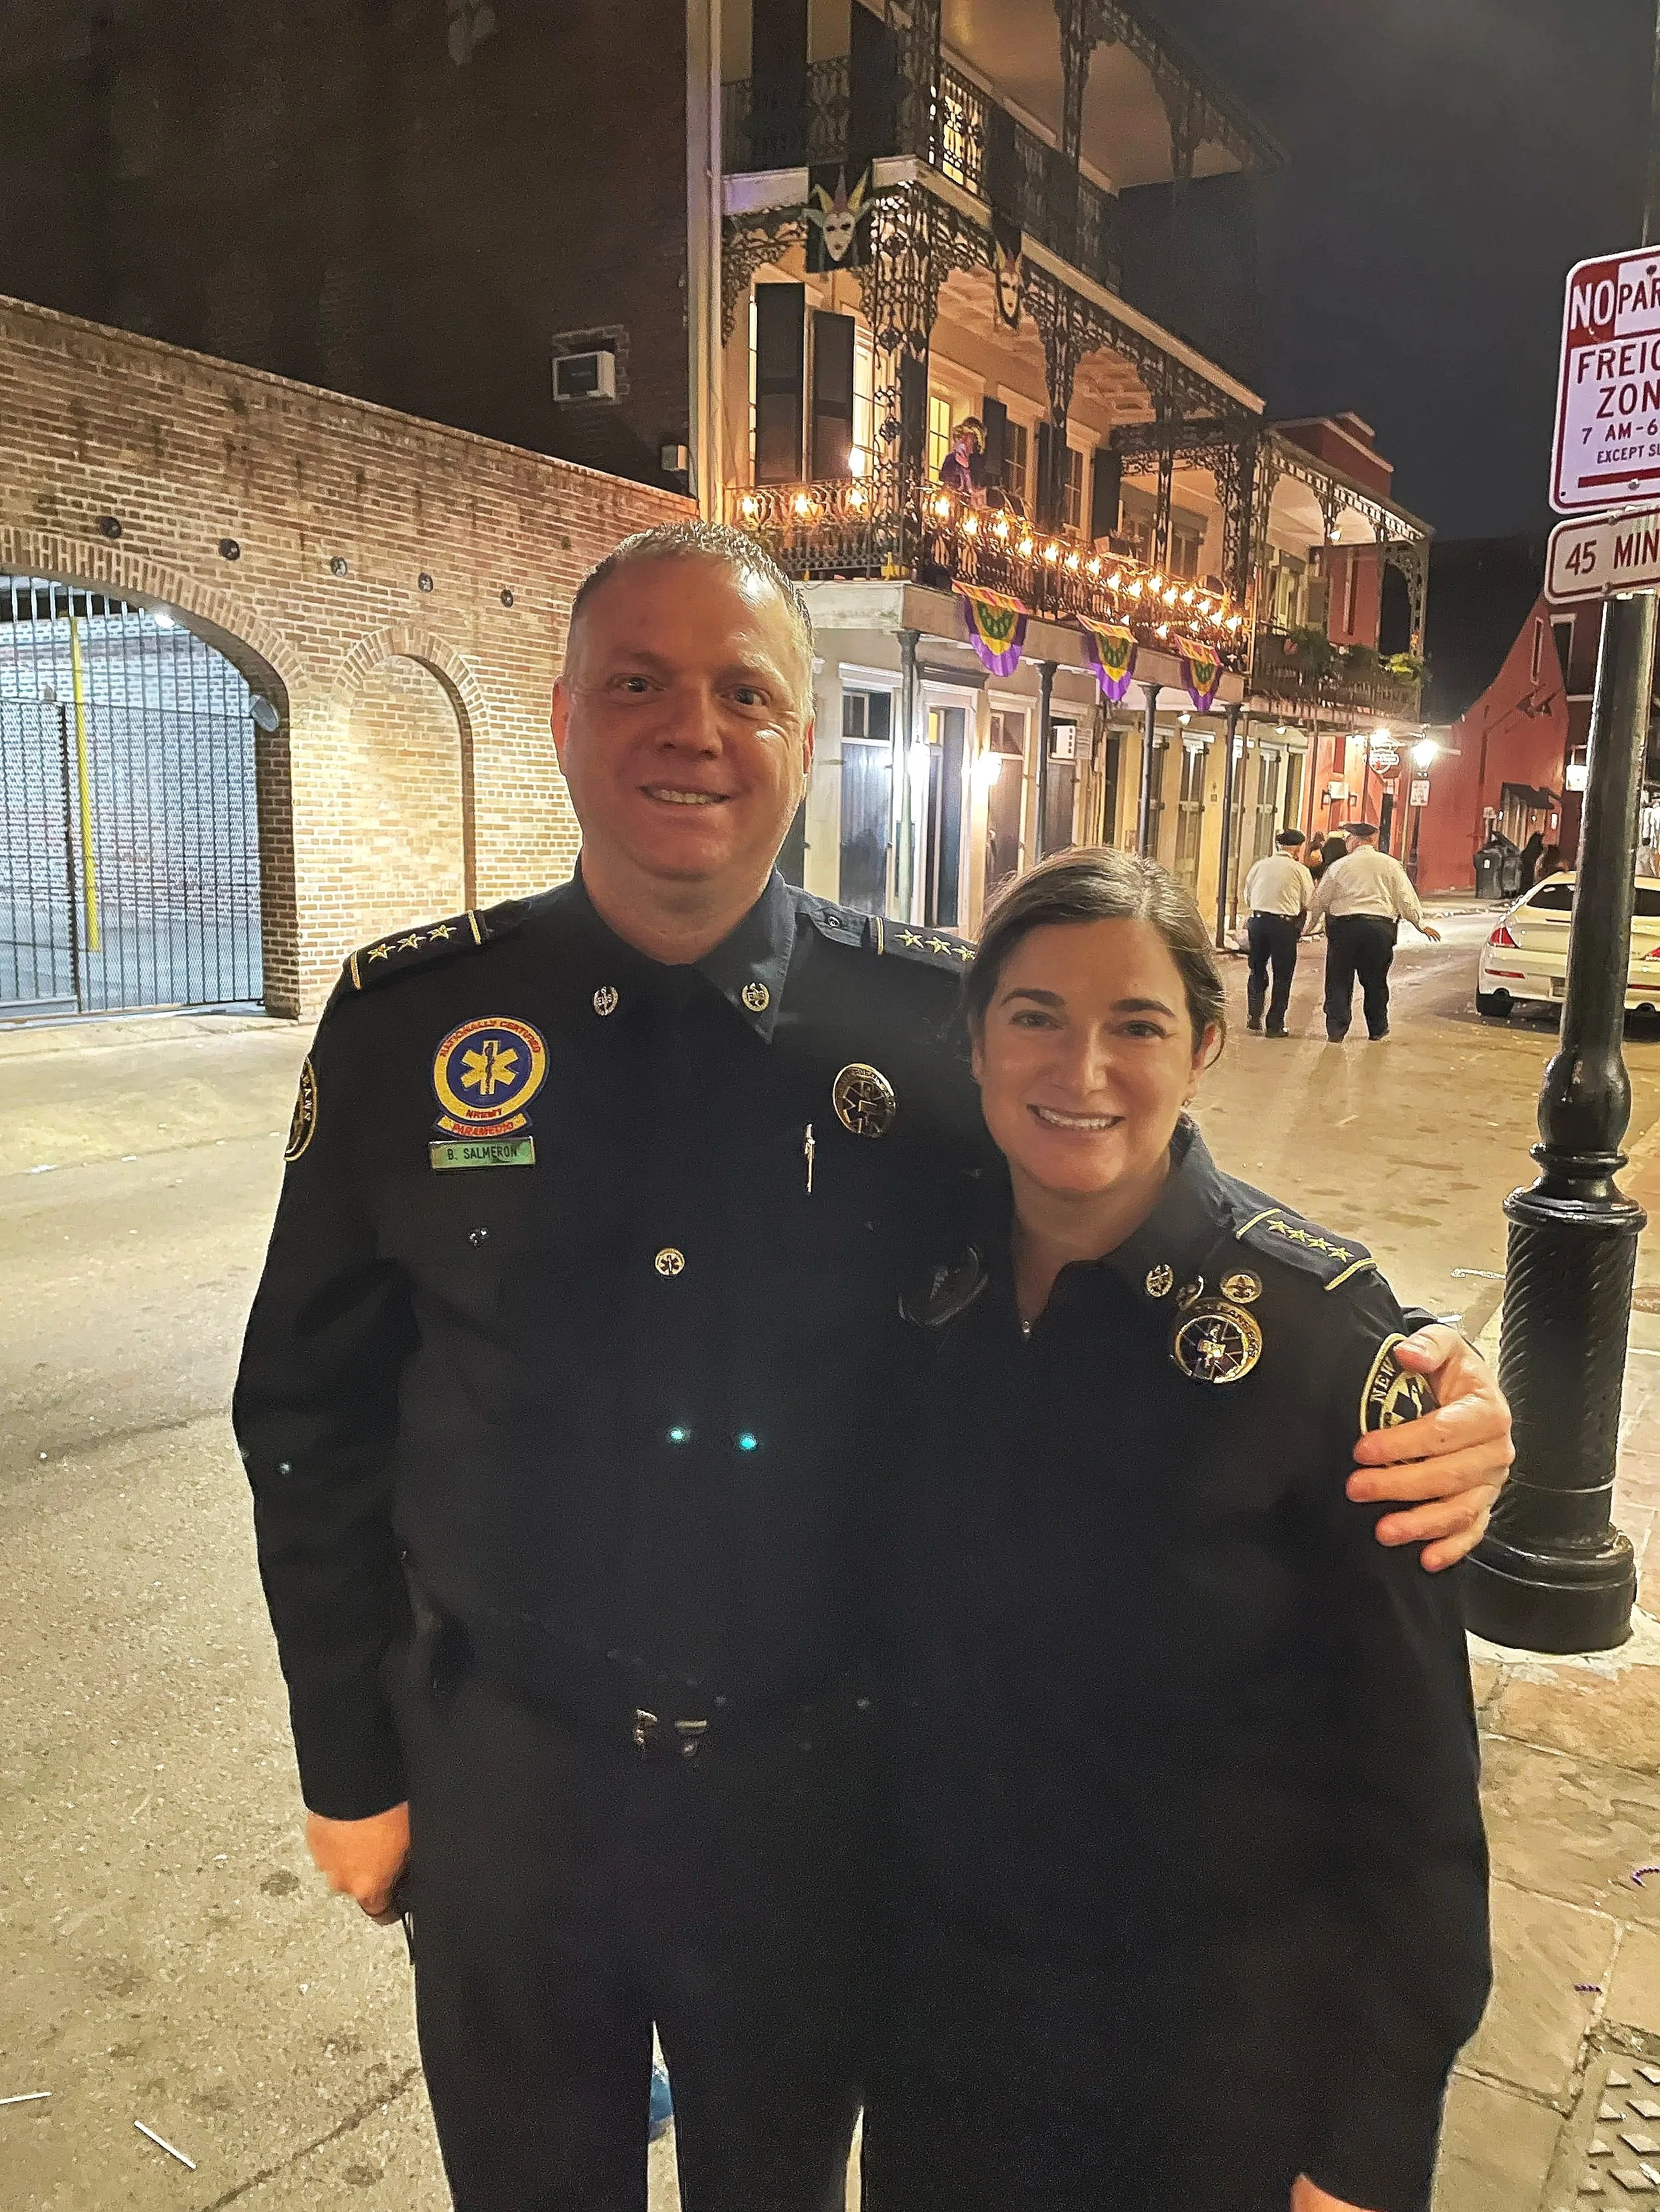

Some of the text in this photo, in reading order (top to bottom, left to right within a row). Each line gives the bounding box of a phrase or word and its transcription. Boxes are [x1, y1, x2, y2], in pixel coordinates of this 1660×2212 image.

[1570, 279, 1616, 330] NO
[1596, 379, 1660, 419] ZON
[1582, 427, 1593, 445] 7
[1597, 445, 1645, 463] EXCEPT
[1564, 528, 1660, 576] 45 MIN
[447, 1145, 518, 1160] B. SALMERON
